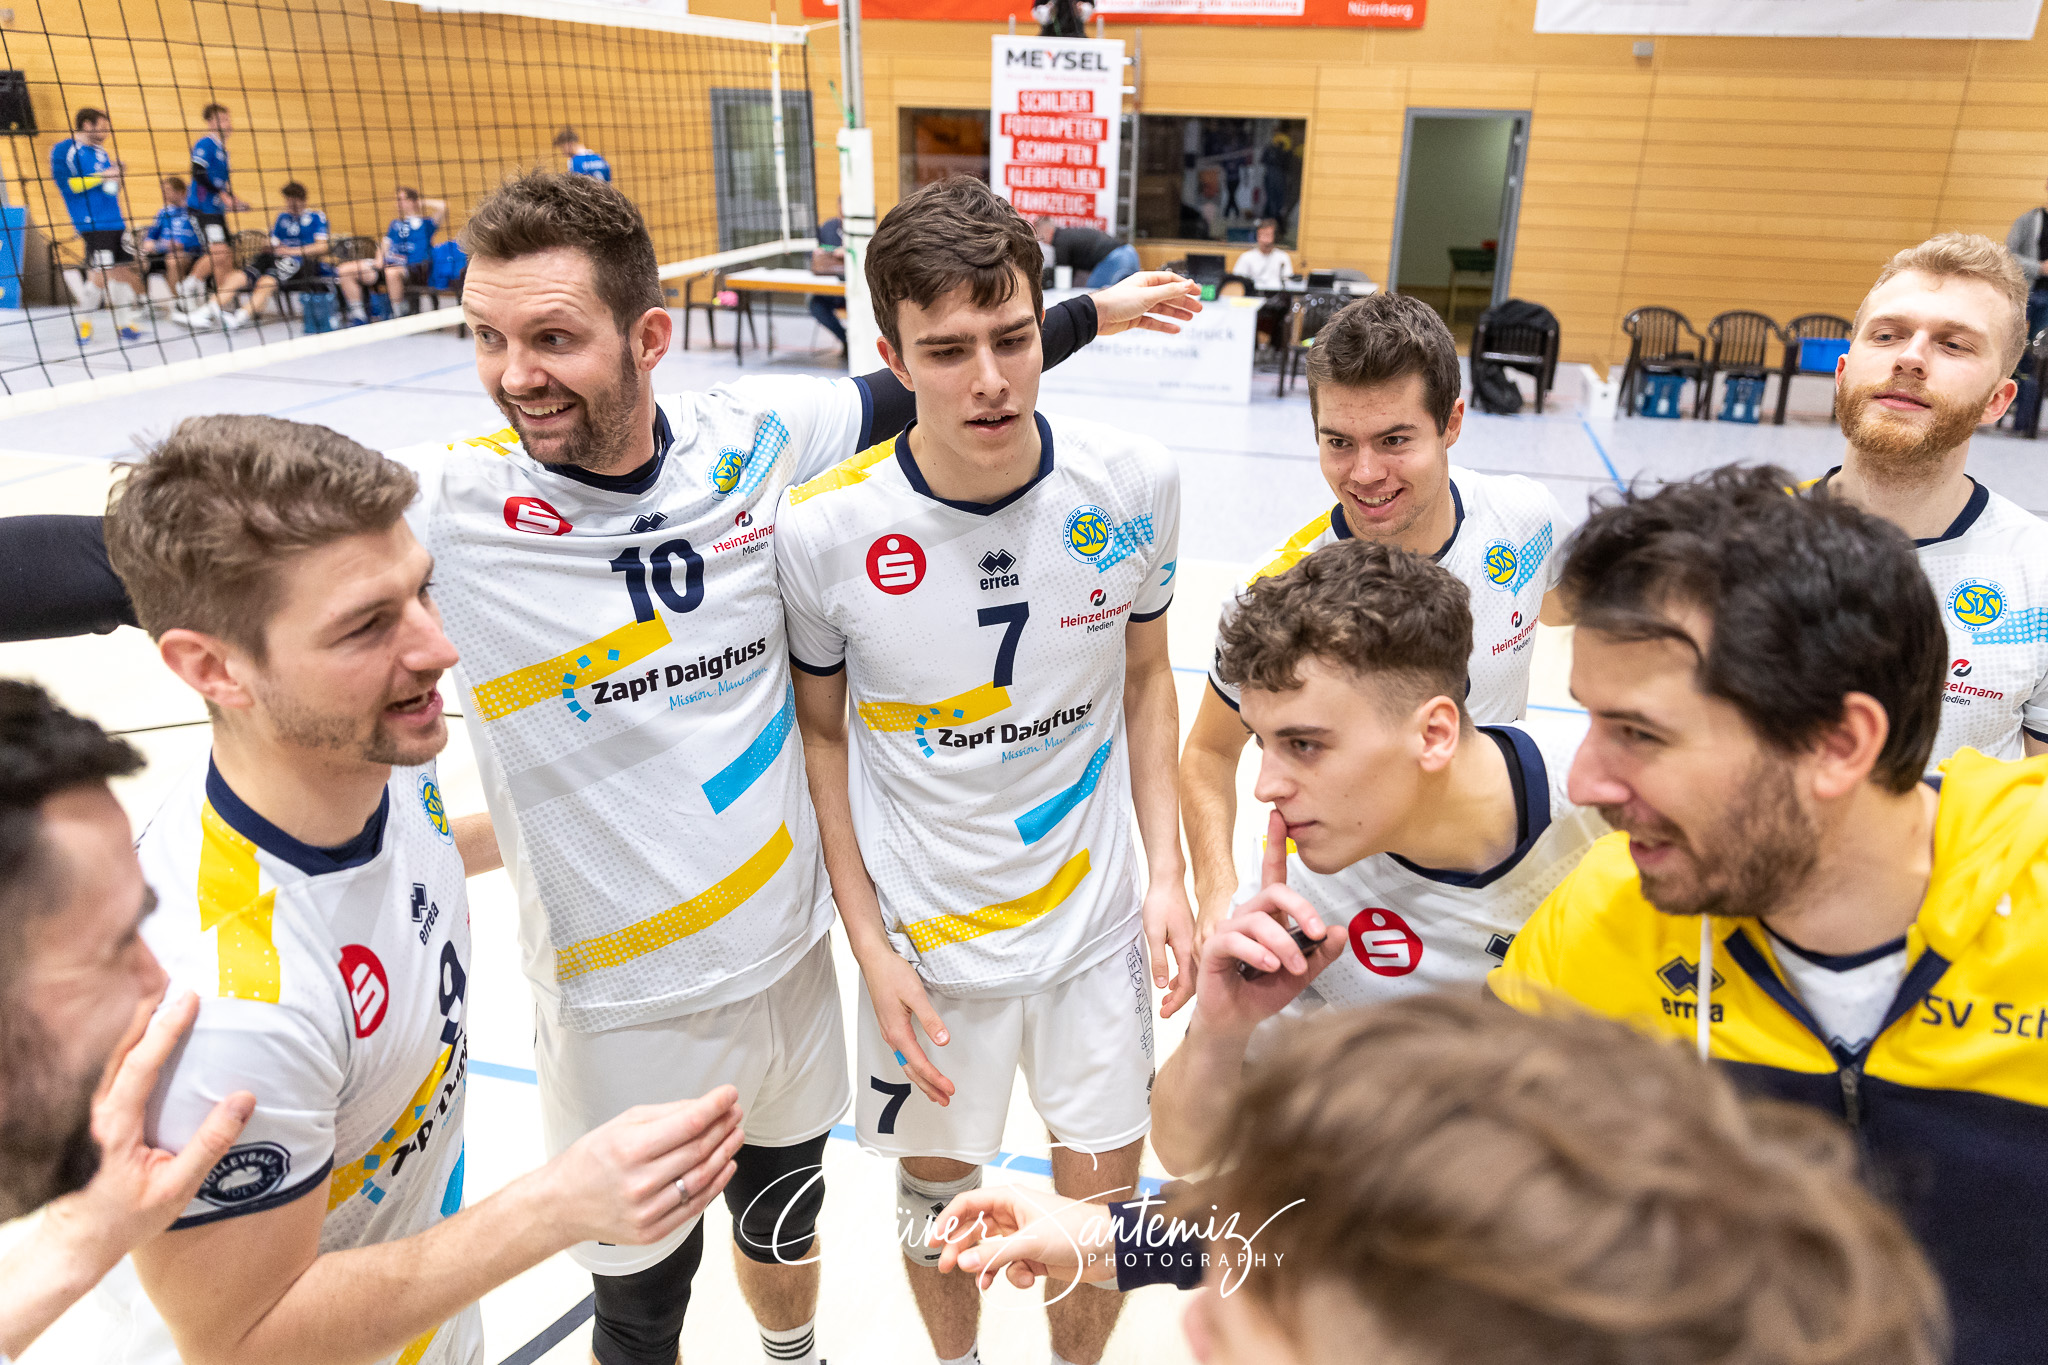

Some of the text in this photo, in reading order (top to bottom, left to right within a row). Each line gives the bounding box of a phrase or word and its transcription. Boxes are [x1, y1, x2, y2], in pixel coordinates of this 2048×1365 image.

[1348, 0, 1414, 21] Nürnberg
[1006, 49, 1109, 71] MEYSEL
[1020, 91, 1091, 113] SCHILDER
[1004, 114, 1103, 139] FOTOTAPETEN
[1016, 140, 1094, 165] SCHRIFTEN
[1007, 166, 1101, 188] KLEBEFOLIEN
[712, 523, 775, 553] Heinzelma
[742, 541, 769, 556] Medien
[608, 538, 705, 624] 10
[979, 573, 1020, 591] errea
[1060, 600, 1132, 629] Heinzelmann
[1086, 620, 1114, 633] Medien
[977, 601, 1030, 688] 7
[591, 637, 766, 704] Zapf Daigfuss
[1943, 681, 2004, 700] zelmann
[938, 699, 1093, 749] Zapf Daigfuss
[419, 901, 440, 946] errea
[1661, 997, 1724, 1023] erra
[1921, 993, 1973, 1029] SV
[870, 1075, 912, 1135] 7
